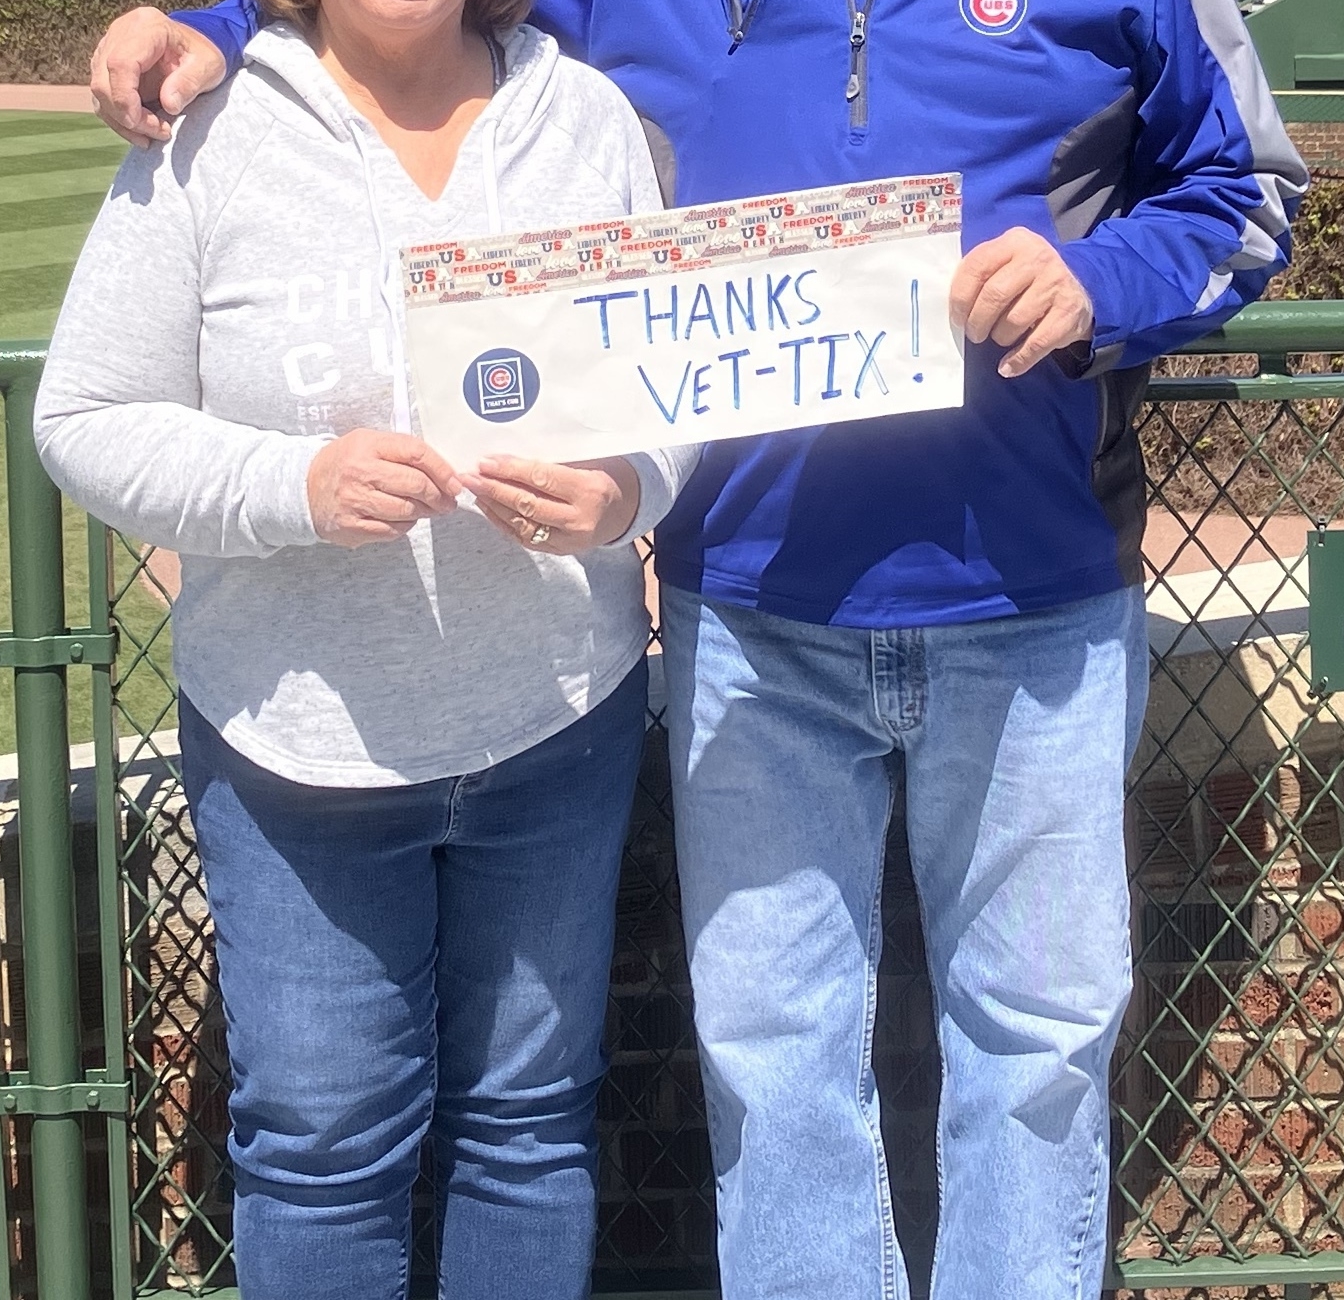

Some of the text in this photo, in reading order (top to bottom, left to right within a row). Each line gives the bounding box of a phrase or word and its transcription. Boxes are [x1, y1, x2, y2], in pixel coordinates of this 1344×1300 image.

[903, 177, 949, 187] FREEDOM
[742, 196, 788, 210] FREEDOM
[867, 193, 899, 206] USA
[769, 201, 809, 219] USA
[811, 202, 840, 214] LIBERTY
[901, 200, 941, 215] USA
[783, 214, 834, 229] FREEDOM
[837, 209, 867, 222] LIBERTY
[578, 220, 625, 233] FREEDOM
[606, 224, 648, 242] USA
[741, 223, 781, 239] USA
[814, 222, 861, 239] USA
[410, 242, 458, 254] FREEDOM
[542, 239, 576, 252] USA
[620, 238, 673, 253] FREEDOM
[676, 234, 706, 247] LIBERTY
[439, 248, 482, 264] USA
[482, 248, 513, 260] LIBERTY
[577, 247, 618, 263] USA
[653, 245, 700, 264] USA
[453, 261, 507, 275] FREEDOM
[511, 256, 542, 268] LIBERTY
[410, 267, 452, 284] USA
[487, 268, 536, 286] USA
[573, 269, 824, 349] THANKS
